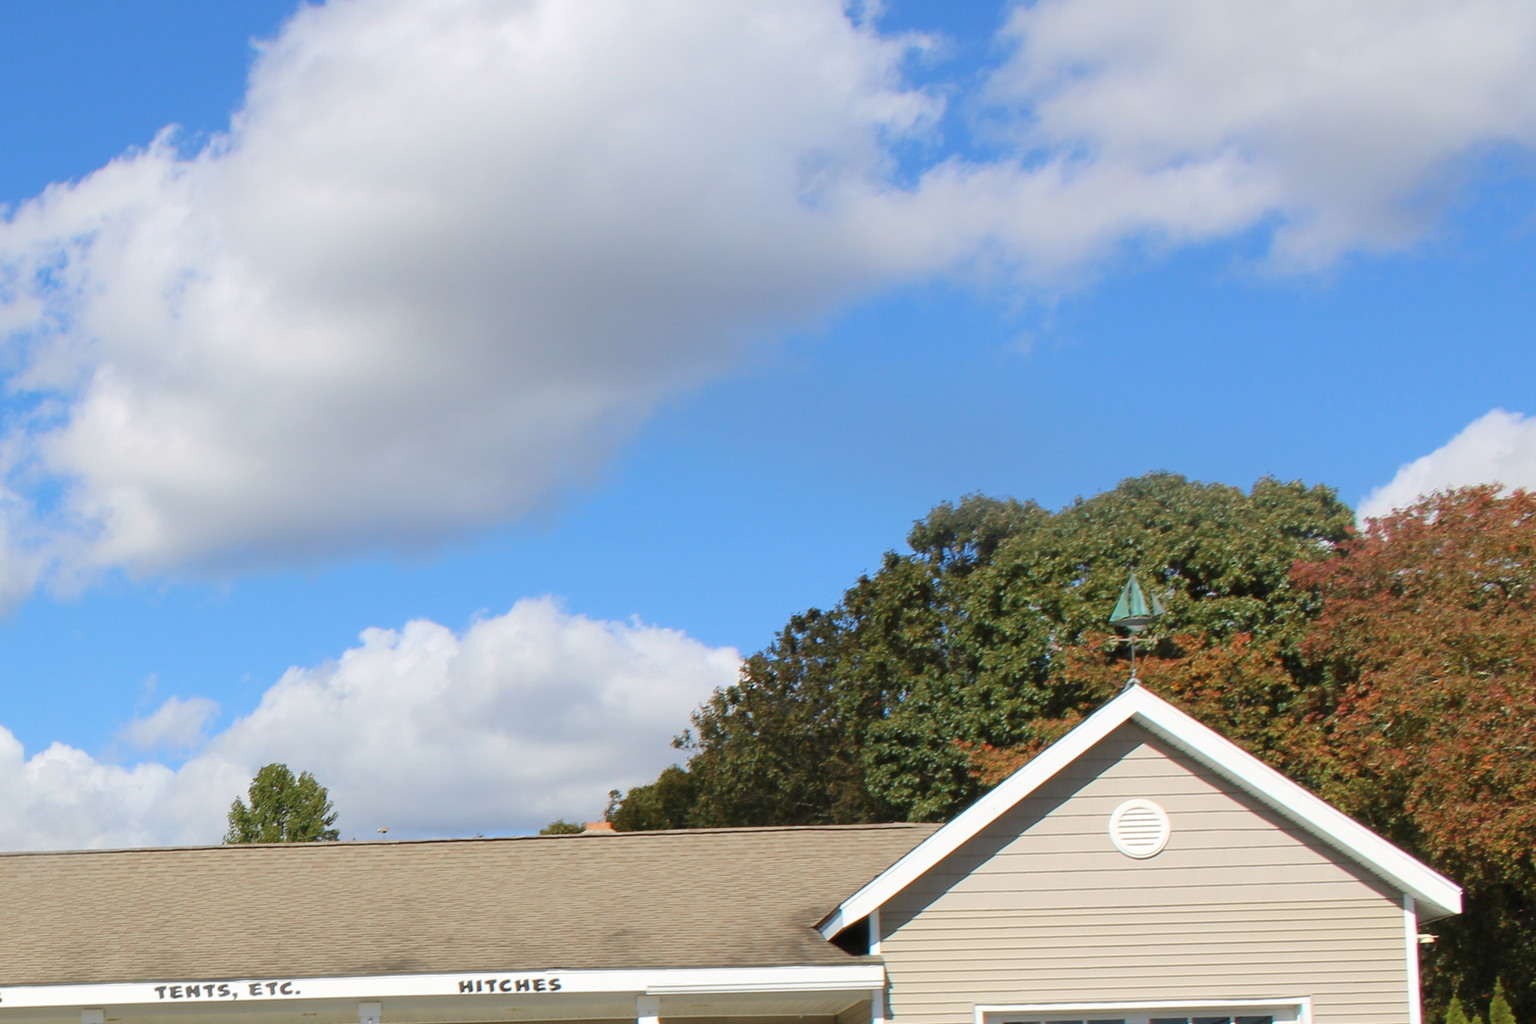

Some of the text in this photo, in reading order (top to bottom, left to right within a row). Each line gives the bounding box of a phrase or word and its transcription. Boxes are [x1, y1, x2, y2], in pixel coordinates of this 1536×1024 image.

[154, 982, 301, 1001] TENTS, ETC.
[458, 978, 562, 993] HITCHES
